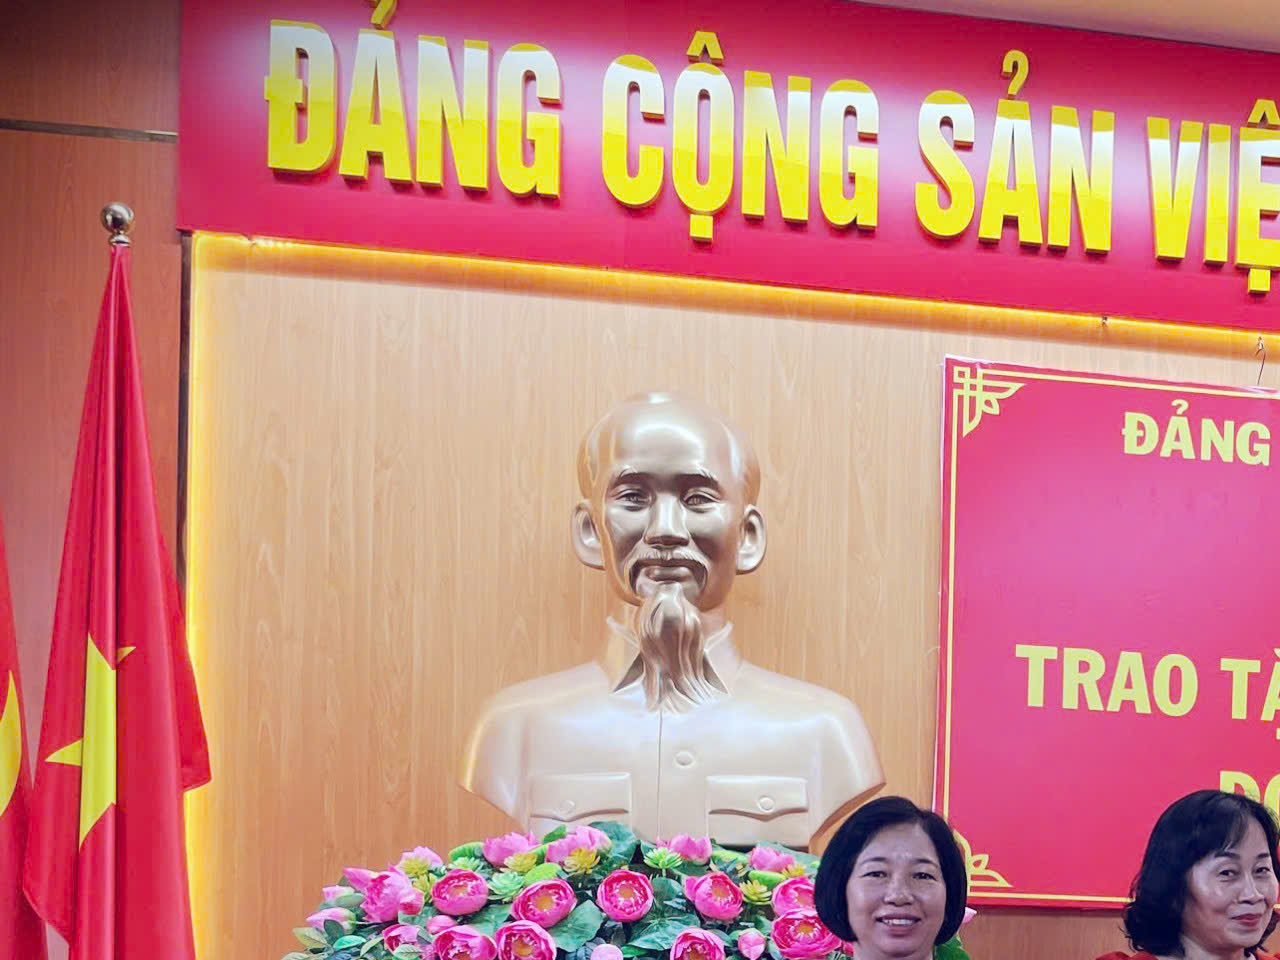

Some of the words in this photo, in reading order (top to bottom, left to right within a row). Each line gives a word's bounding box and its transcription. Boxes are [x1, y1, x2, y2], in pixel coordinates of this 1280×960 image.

[264, 0, 564, 200] ĐẢNG
[601, 31, 880, 242] CỘNG
[915, 49, 1115, 254] SẢN
[1122, 399, 1270, 466] ĐẢNG
[1015, 643, 1199, 718] TRAO
